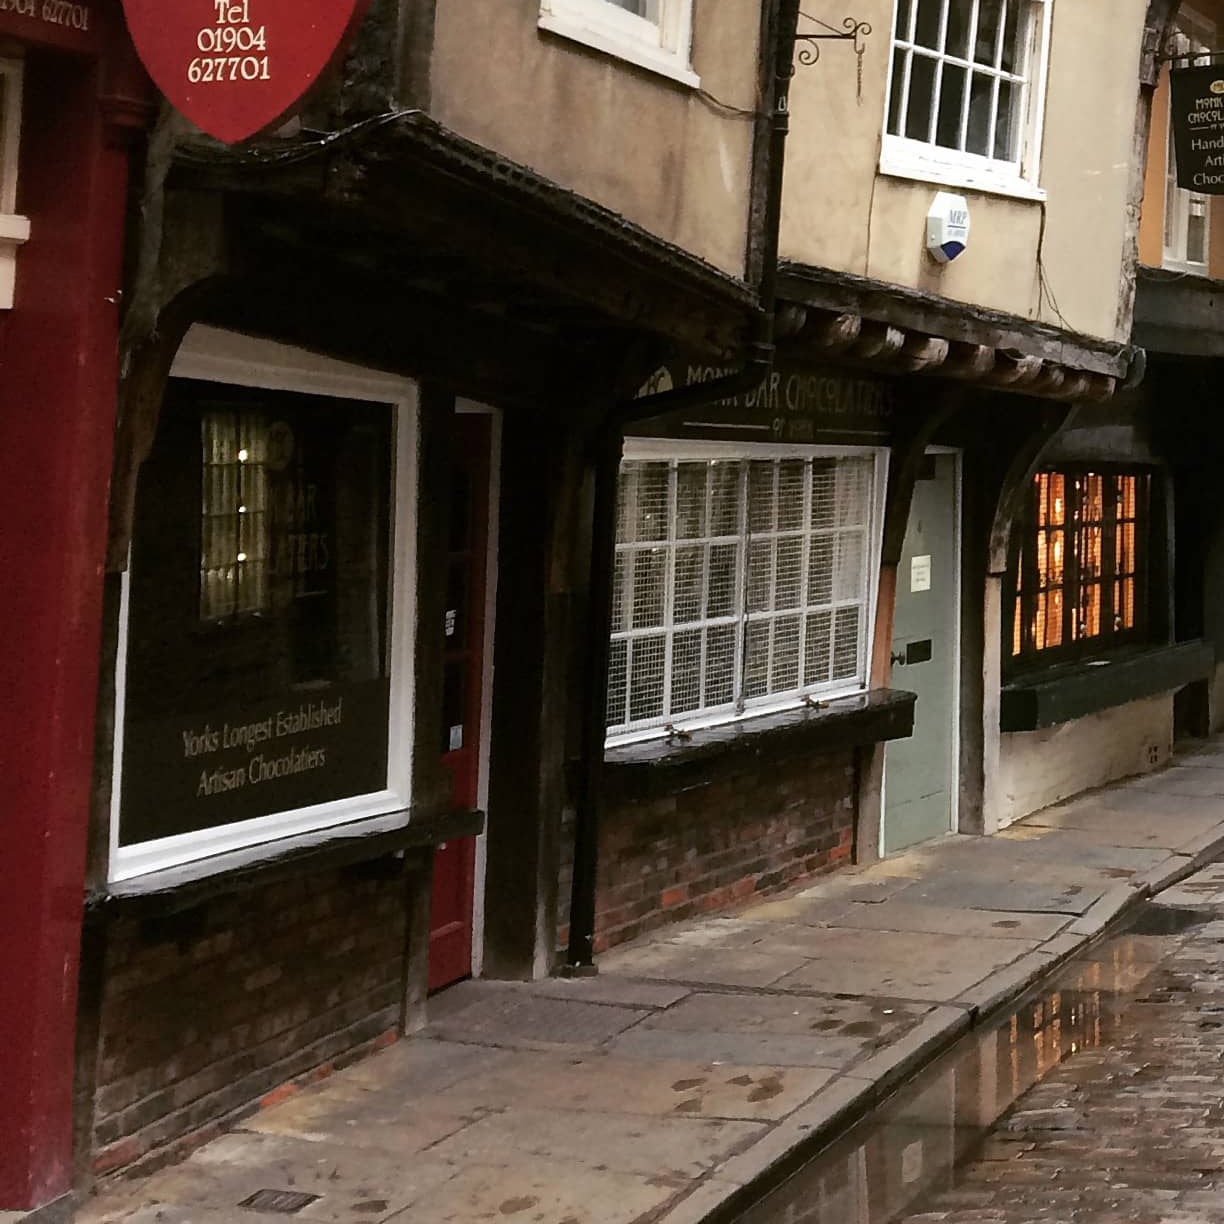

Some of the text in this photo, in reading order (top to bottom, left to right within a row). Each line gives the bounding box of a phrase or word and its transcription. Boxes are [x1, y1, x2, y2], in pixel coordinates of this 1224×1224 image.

[197, 26, 267, 53] 01904
[187, 57, 271, 84] 627701
[1195, 97, 1224, 111] MONK
[223, 717, 273, 752] Longest
[276, 696, 343, 736] Established
[197, 747, 326, 797] Artisan Chocolatiers
